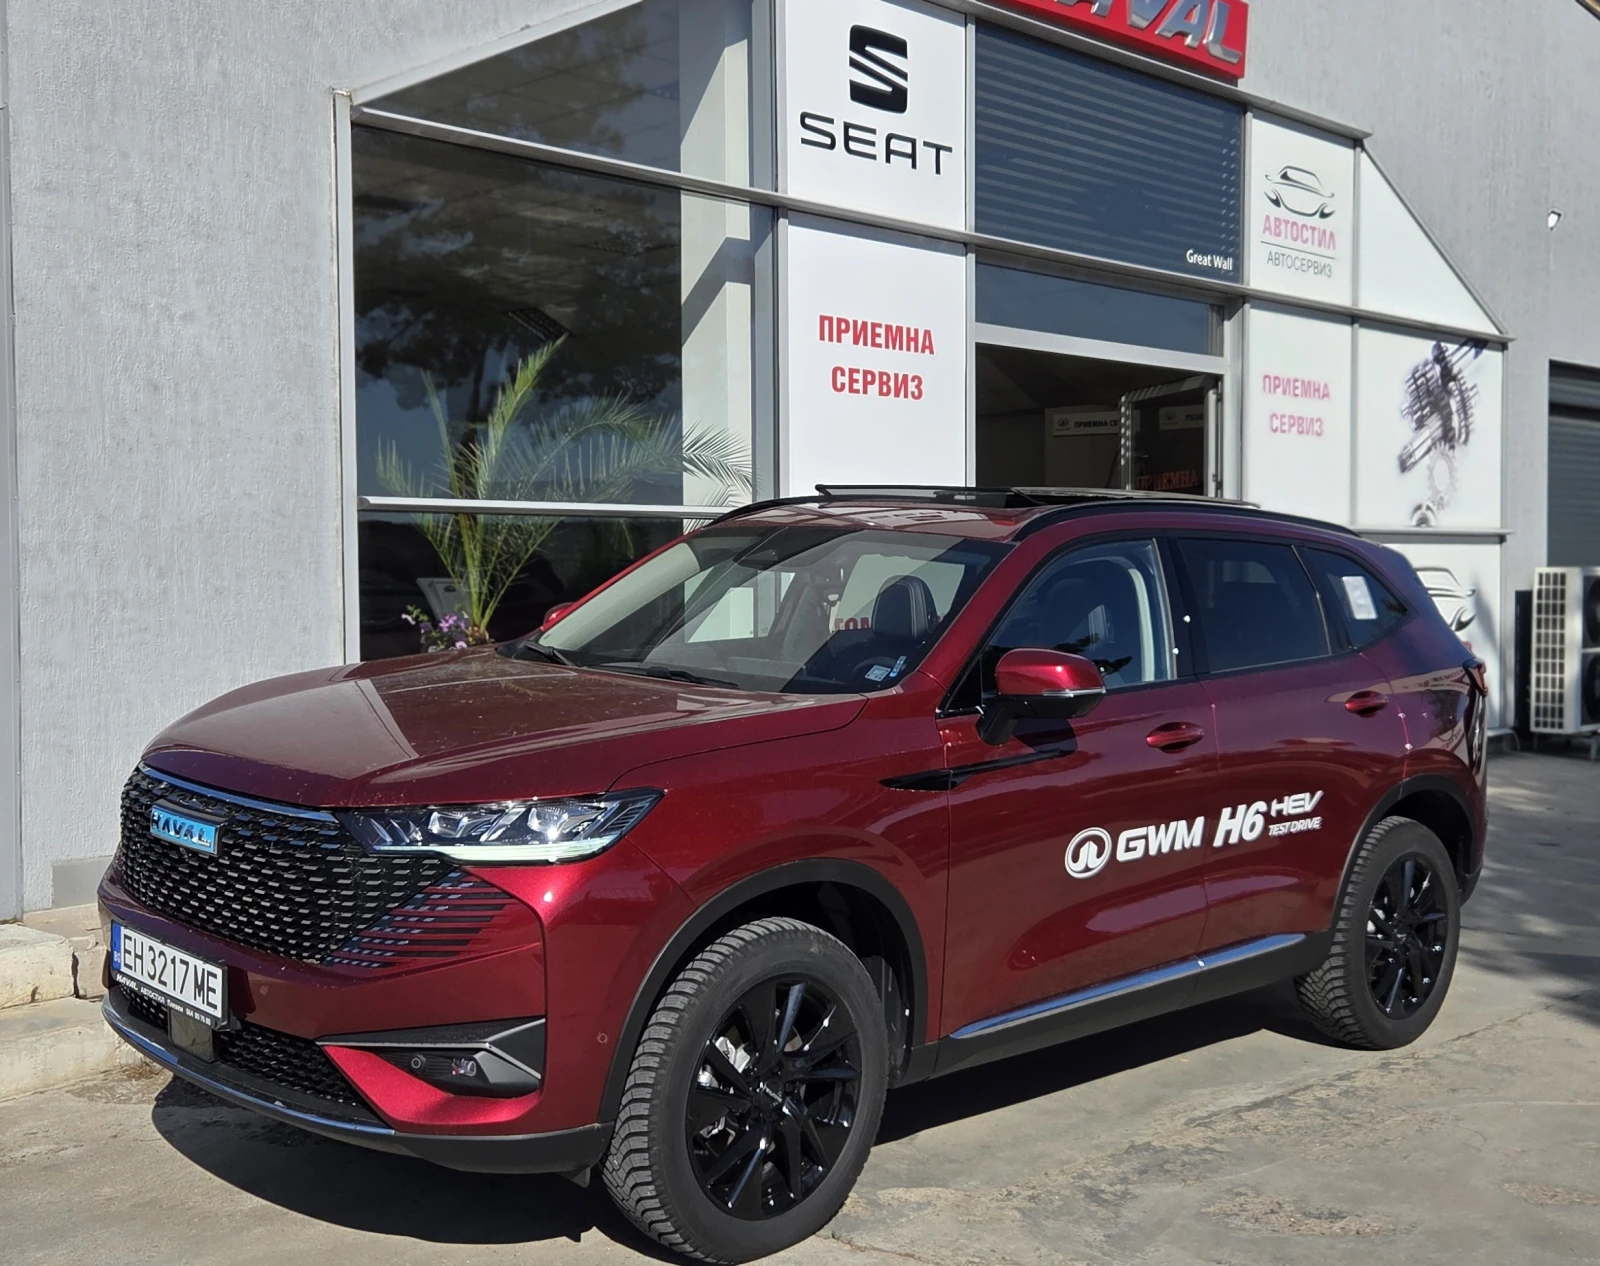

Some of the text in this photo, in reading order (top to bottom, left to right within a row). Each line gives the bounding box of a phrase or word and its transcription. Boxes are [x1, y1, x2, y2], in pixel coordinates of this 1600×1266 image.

[800, 111, 953, 175] SEAT
[1262, 214, 1337, 250] АВТОСТИЛ
[1186, 249, 1233, 271] Great Wall
[1266, 250, 1333, 278] АВТОСЕРВИЗ
[819, 314, 935, 355] ПРИЕМНА
[831, 365, 924, 401] СЕРВИЗ
[1262, 374, 1330, 400] ПРИЕМНА
[1269, 412, 1324, 437] СЕРВИЗ
[1269, 790, 1324, 818] HEV
[152, 811, 212, 847] HAVAL
[1116, 800, 1267, 863] GWM H6
[1268, 816, 1323, 837] TEST DRIVE
[147, 945, 190, 995] 3217
